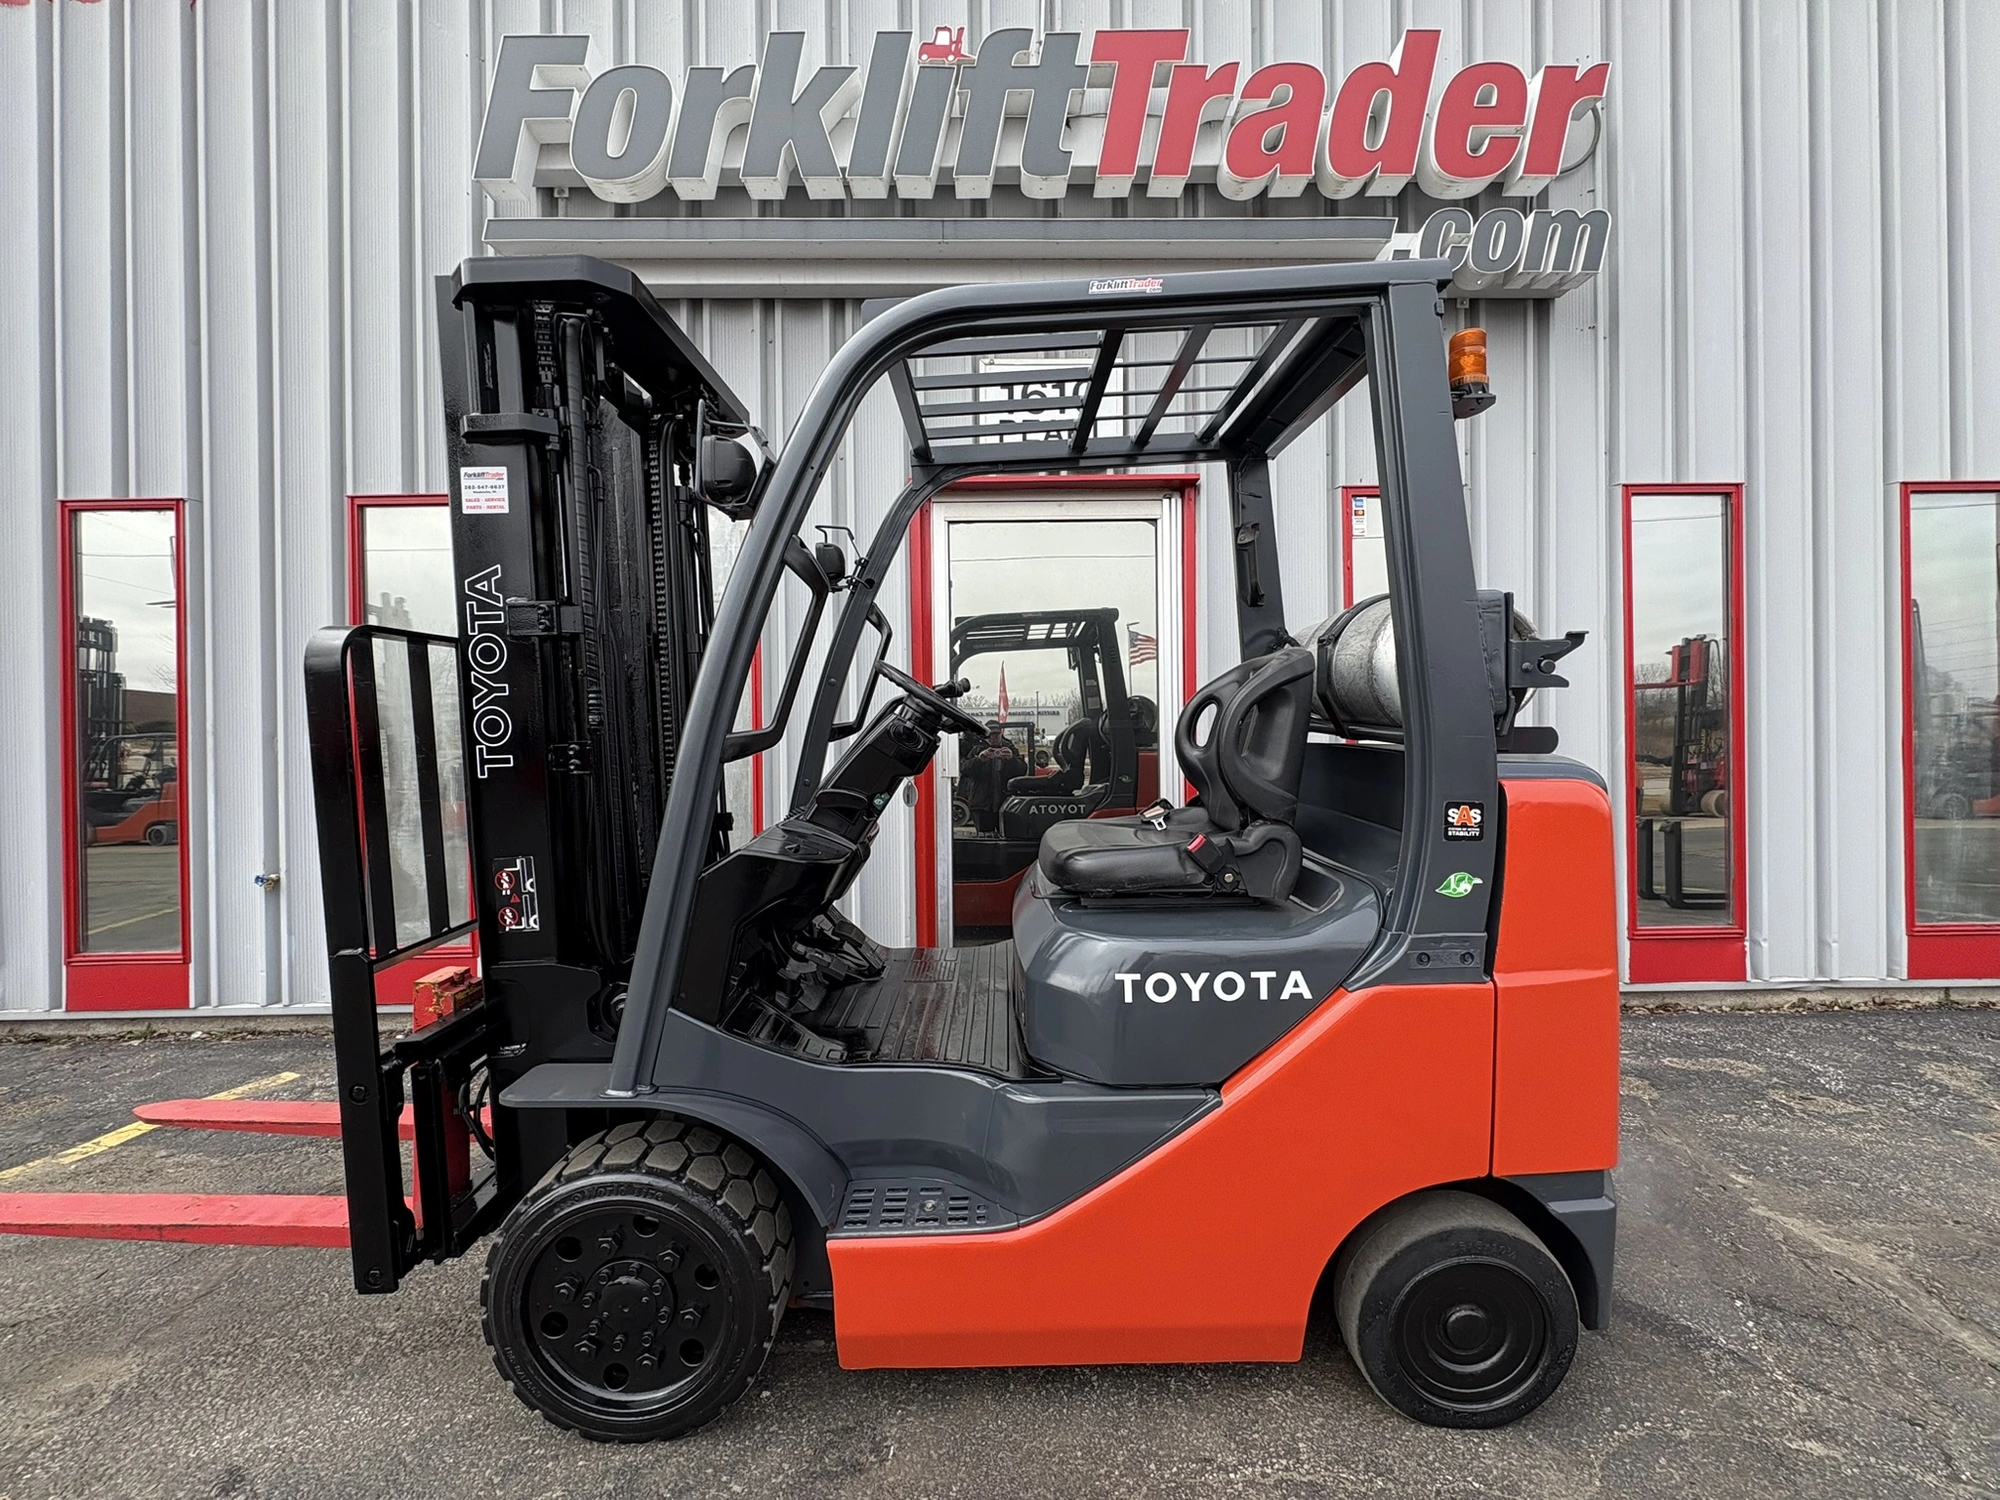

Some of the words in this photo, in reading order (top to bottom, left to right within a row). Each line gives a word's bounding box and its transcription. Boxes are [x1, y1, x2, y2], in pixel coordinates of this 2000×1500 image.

[472, 27, 1609, 181] ForkliftTrader
[1090, 278, 1163, 290] ForkliftTrader
[465, 564, 513, 778] TOYOTA
[1447, 805, 1482, 826] SAS
[1115, 970, 1313, 1003] TOYOTA
